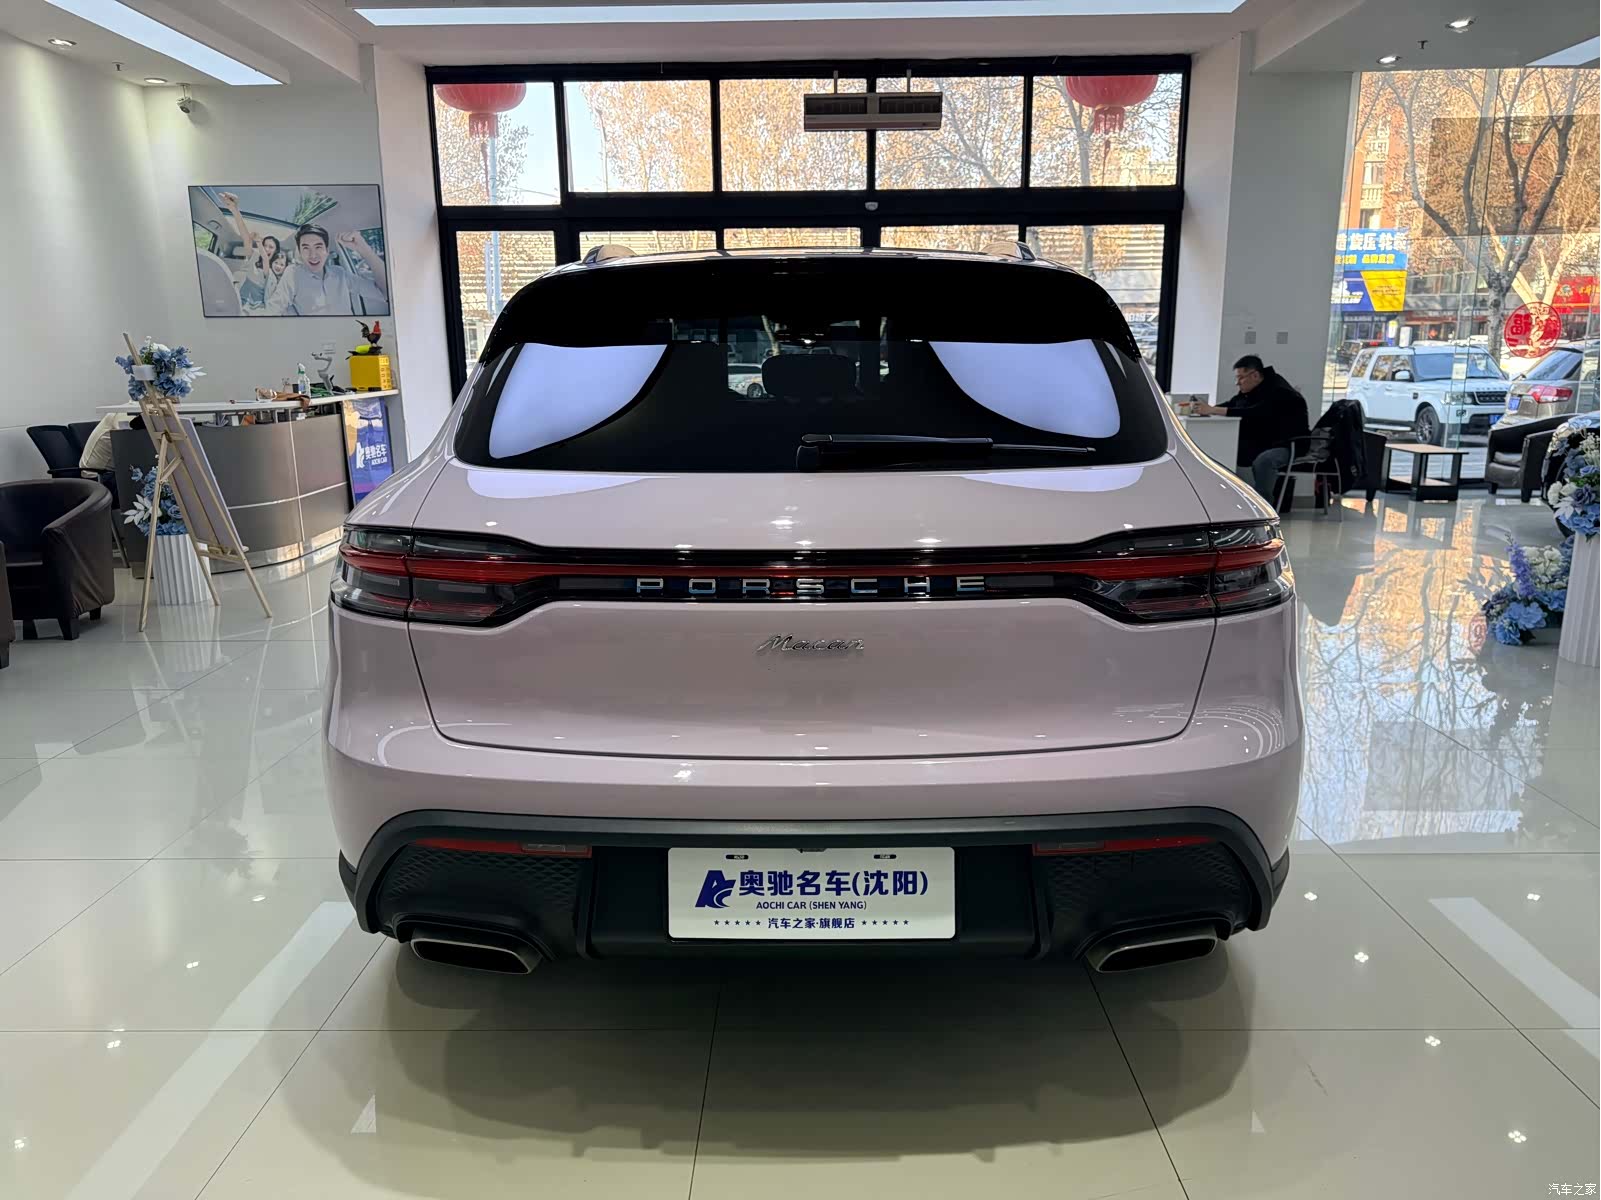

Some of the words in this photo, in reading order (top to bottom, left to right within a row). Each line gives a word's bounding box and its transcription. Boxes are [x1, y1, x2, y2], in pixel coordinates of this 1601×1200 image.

[636, 576, 985, 595] PORSCHE
[755, 633, 865, 652] Macan
[739, 870, 929, 897] 奥驰名车(沈阳)
[756, 901, 785, 910] AOCHI
[787, 901, 807, 910] CAR
[809, 900, 836, 911] (SHEN
[838, 900, 867, 911] YANG)
[767, 917, 856, 930] 汽车之家·旗舰店
